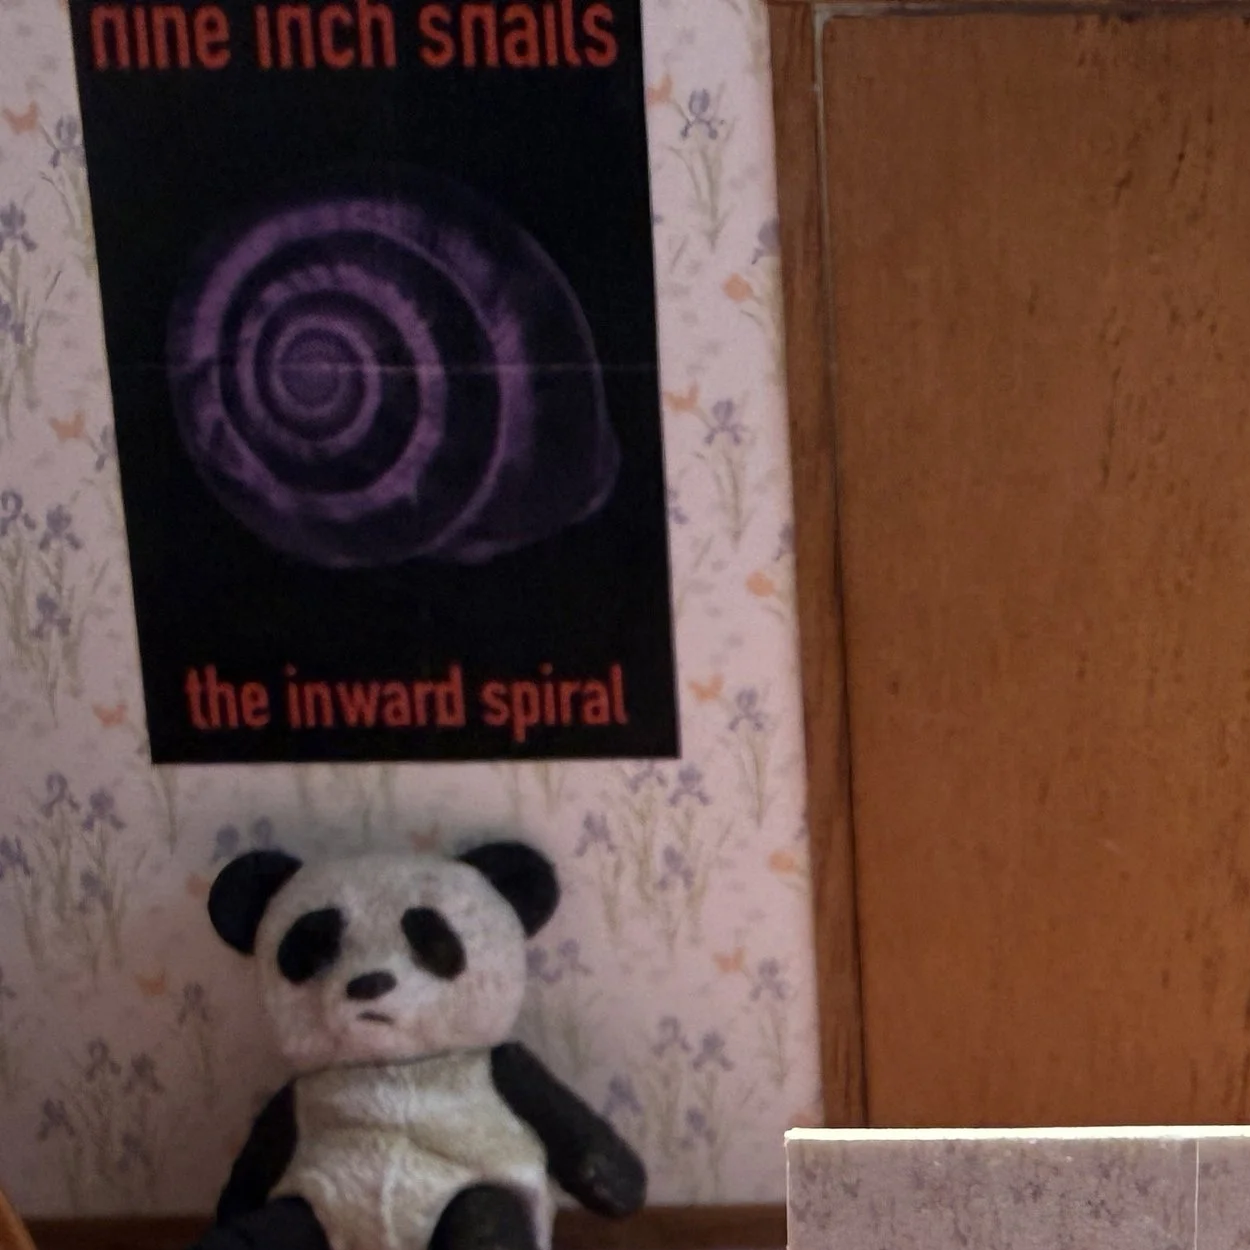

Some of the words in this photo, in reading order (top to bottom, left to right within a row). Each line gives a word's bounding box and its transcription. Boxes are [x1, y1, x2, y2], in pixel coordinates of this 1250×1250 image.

[89, 2, 232, 70] nine
[255, 0, 397, 70] inch
[418, 0, 618, 69] snails
[184, 664, 271, 730] the
[283, 661, 466, 729] inward
[481, 661, 628, 743] spiral
